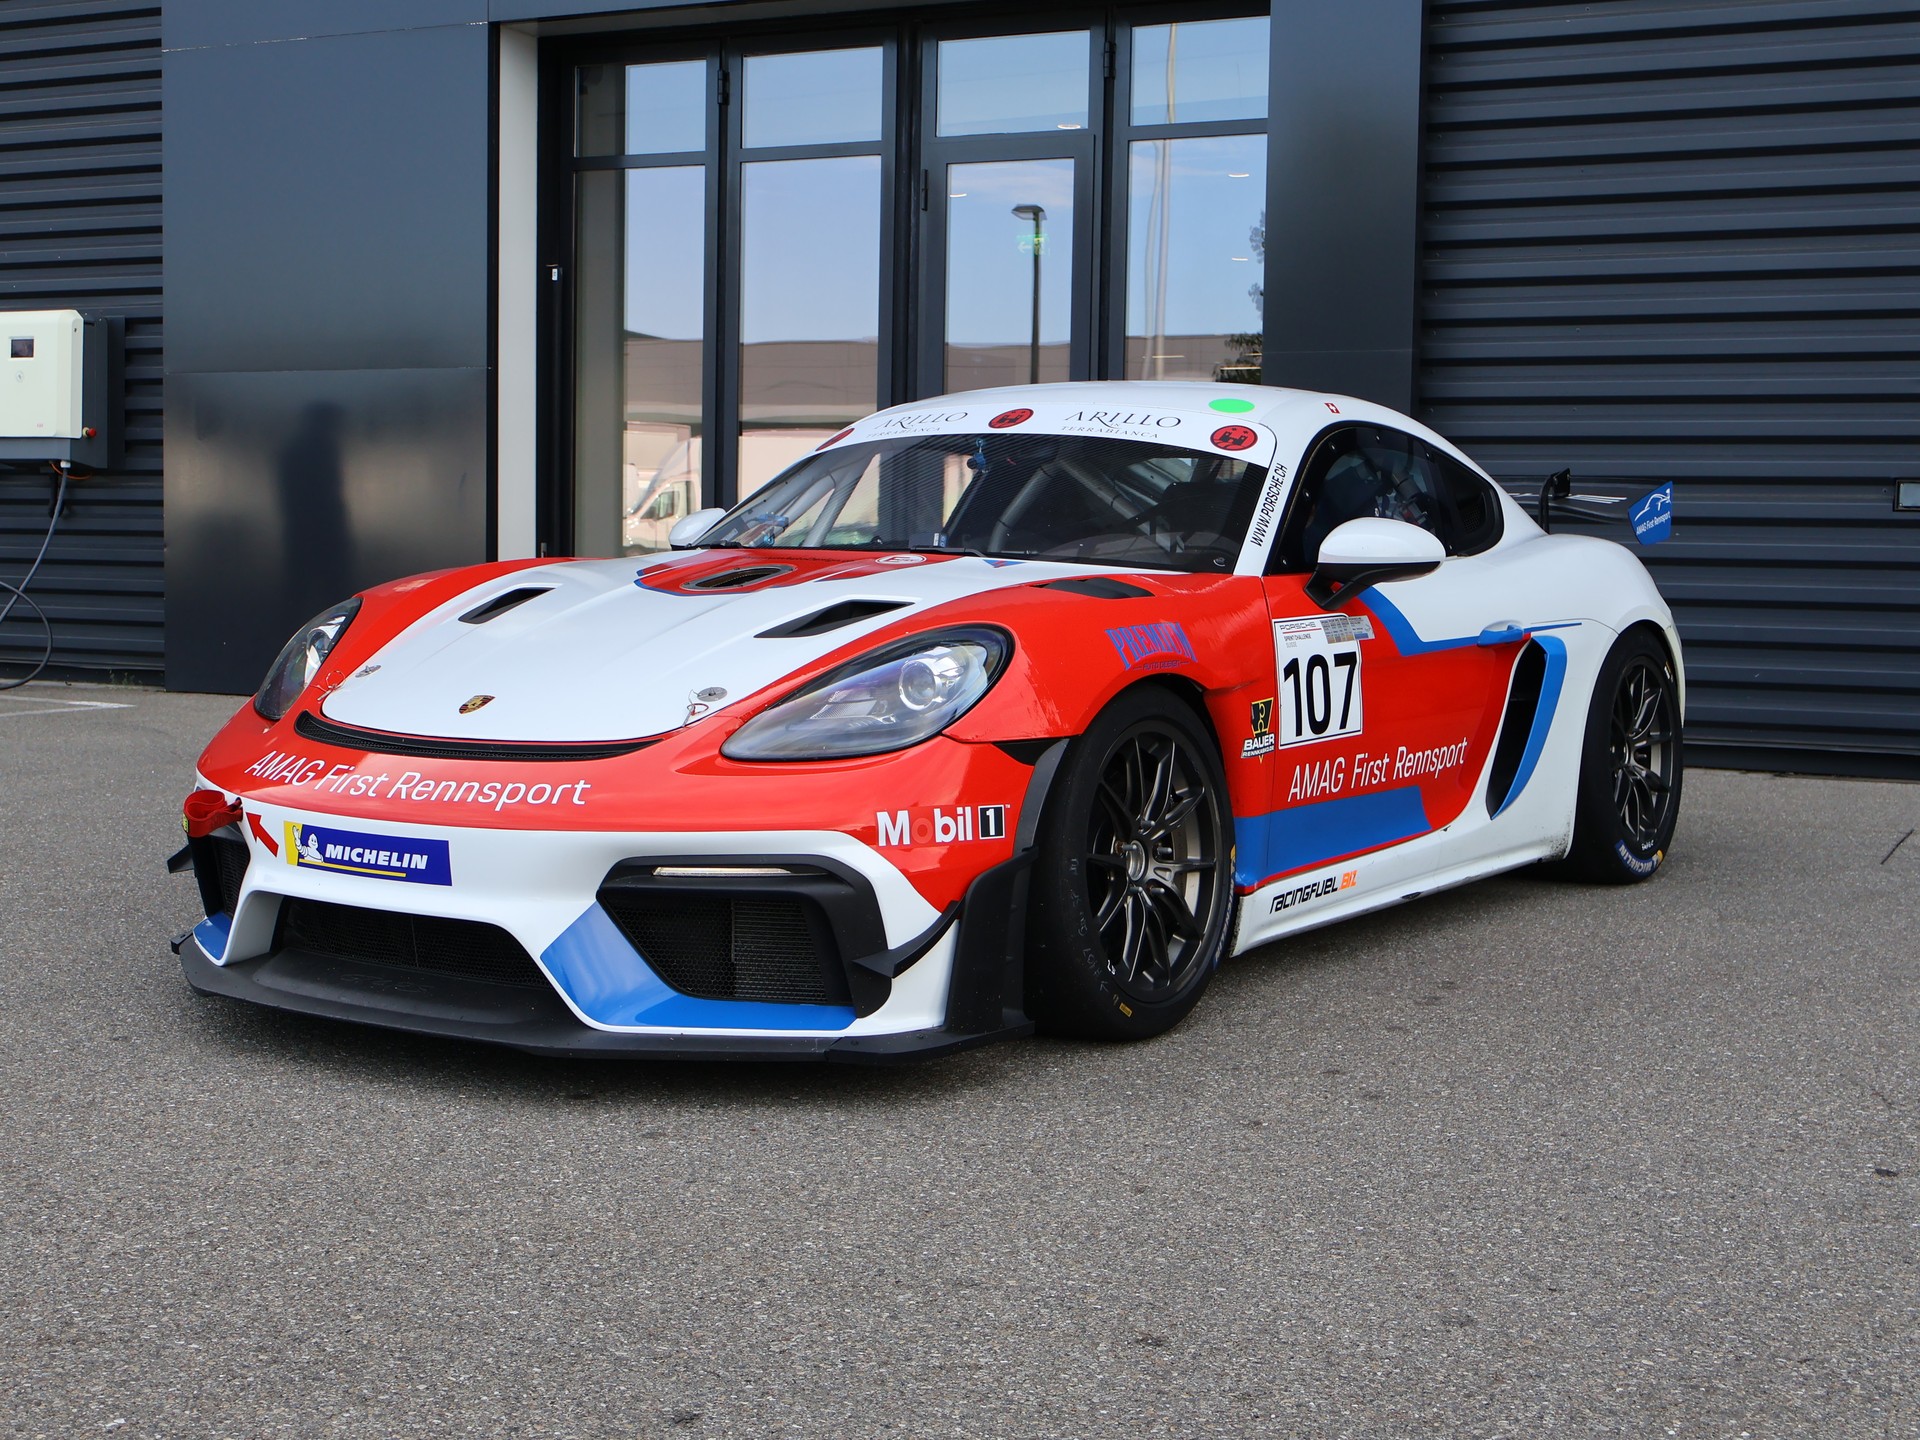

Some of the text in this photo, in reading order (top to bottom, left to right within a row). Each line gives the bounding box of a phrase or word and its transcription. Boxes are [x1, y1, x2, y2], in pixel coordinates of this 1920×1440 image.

[875, 411, 968, 430] ARILLO
[1061, 426, 1158, 438] TERRABIANCA
[1064, 410, 1181, 430] ARILLO
[1250, 462, 1288, 547] WWW.PORSCHE.CH
[1280, 621, 1317, 631] PORSCHE
[1104, 622, 1198, 671] PREMIUM
[1283, 651, 1358, 738] 107
[1243, 733, 1275, 751] BAUER
[244, 750, 592, 812] AMAG First Rennsport
[1287, 736, 1468, 803] AMAG First Rennsport
[876, 806, 973, 847] Mobil
[325, 843, 429, 870] MICHELIN
